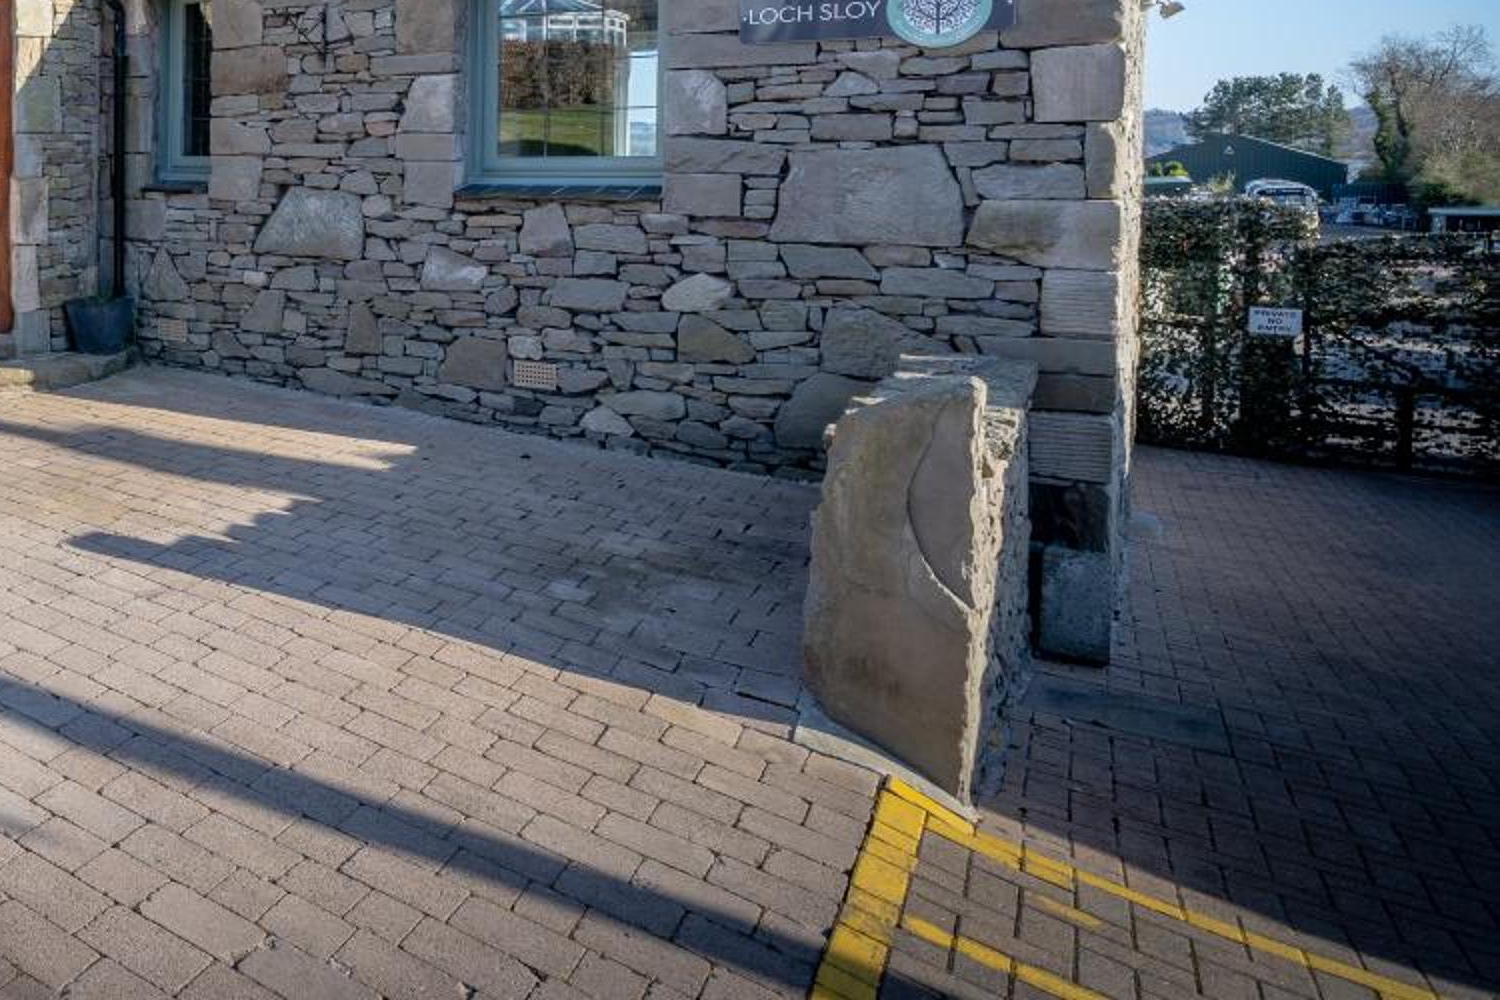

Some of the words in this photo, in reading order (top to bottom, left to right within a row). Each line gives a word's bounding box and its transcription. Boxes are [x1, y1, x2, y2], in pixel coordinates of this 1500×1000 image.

[749, 4, 814, 26] LOCH
[819, 0, 881, 21] SLOY
[1254, 310, 1296, 319] PRIVATE
